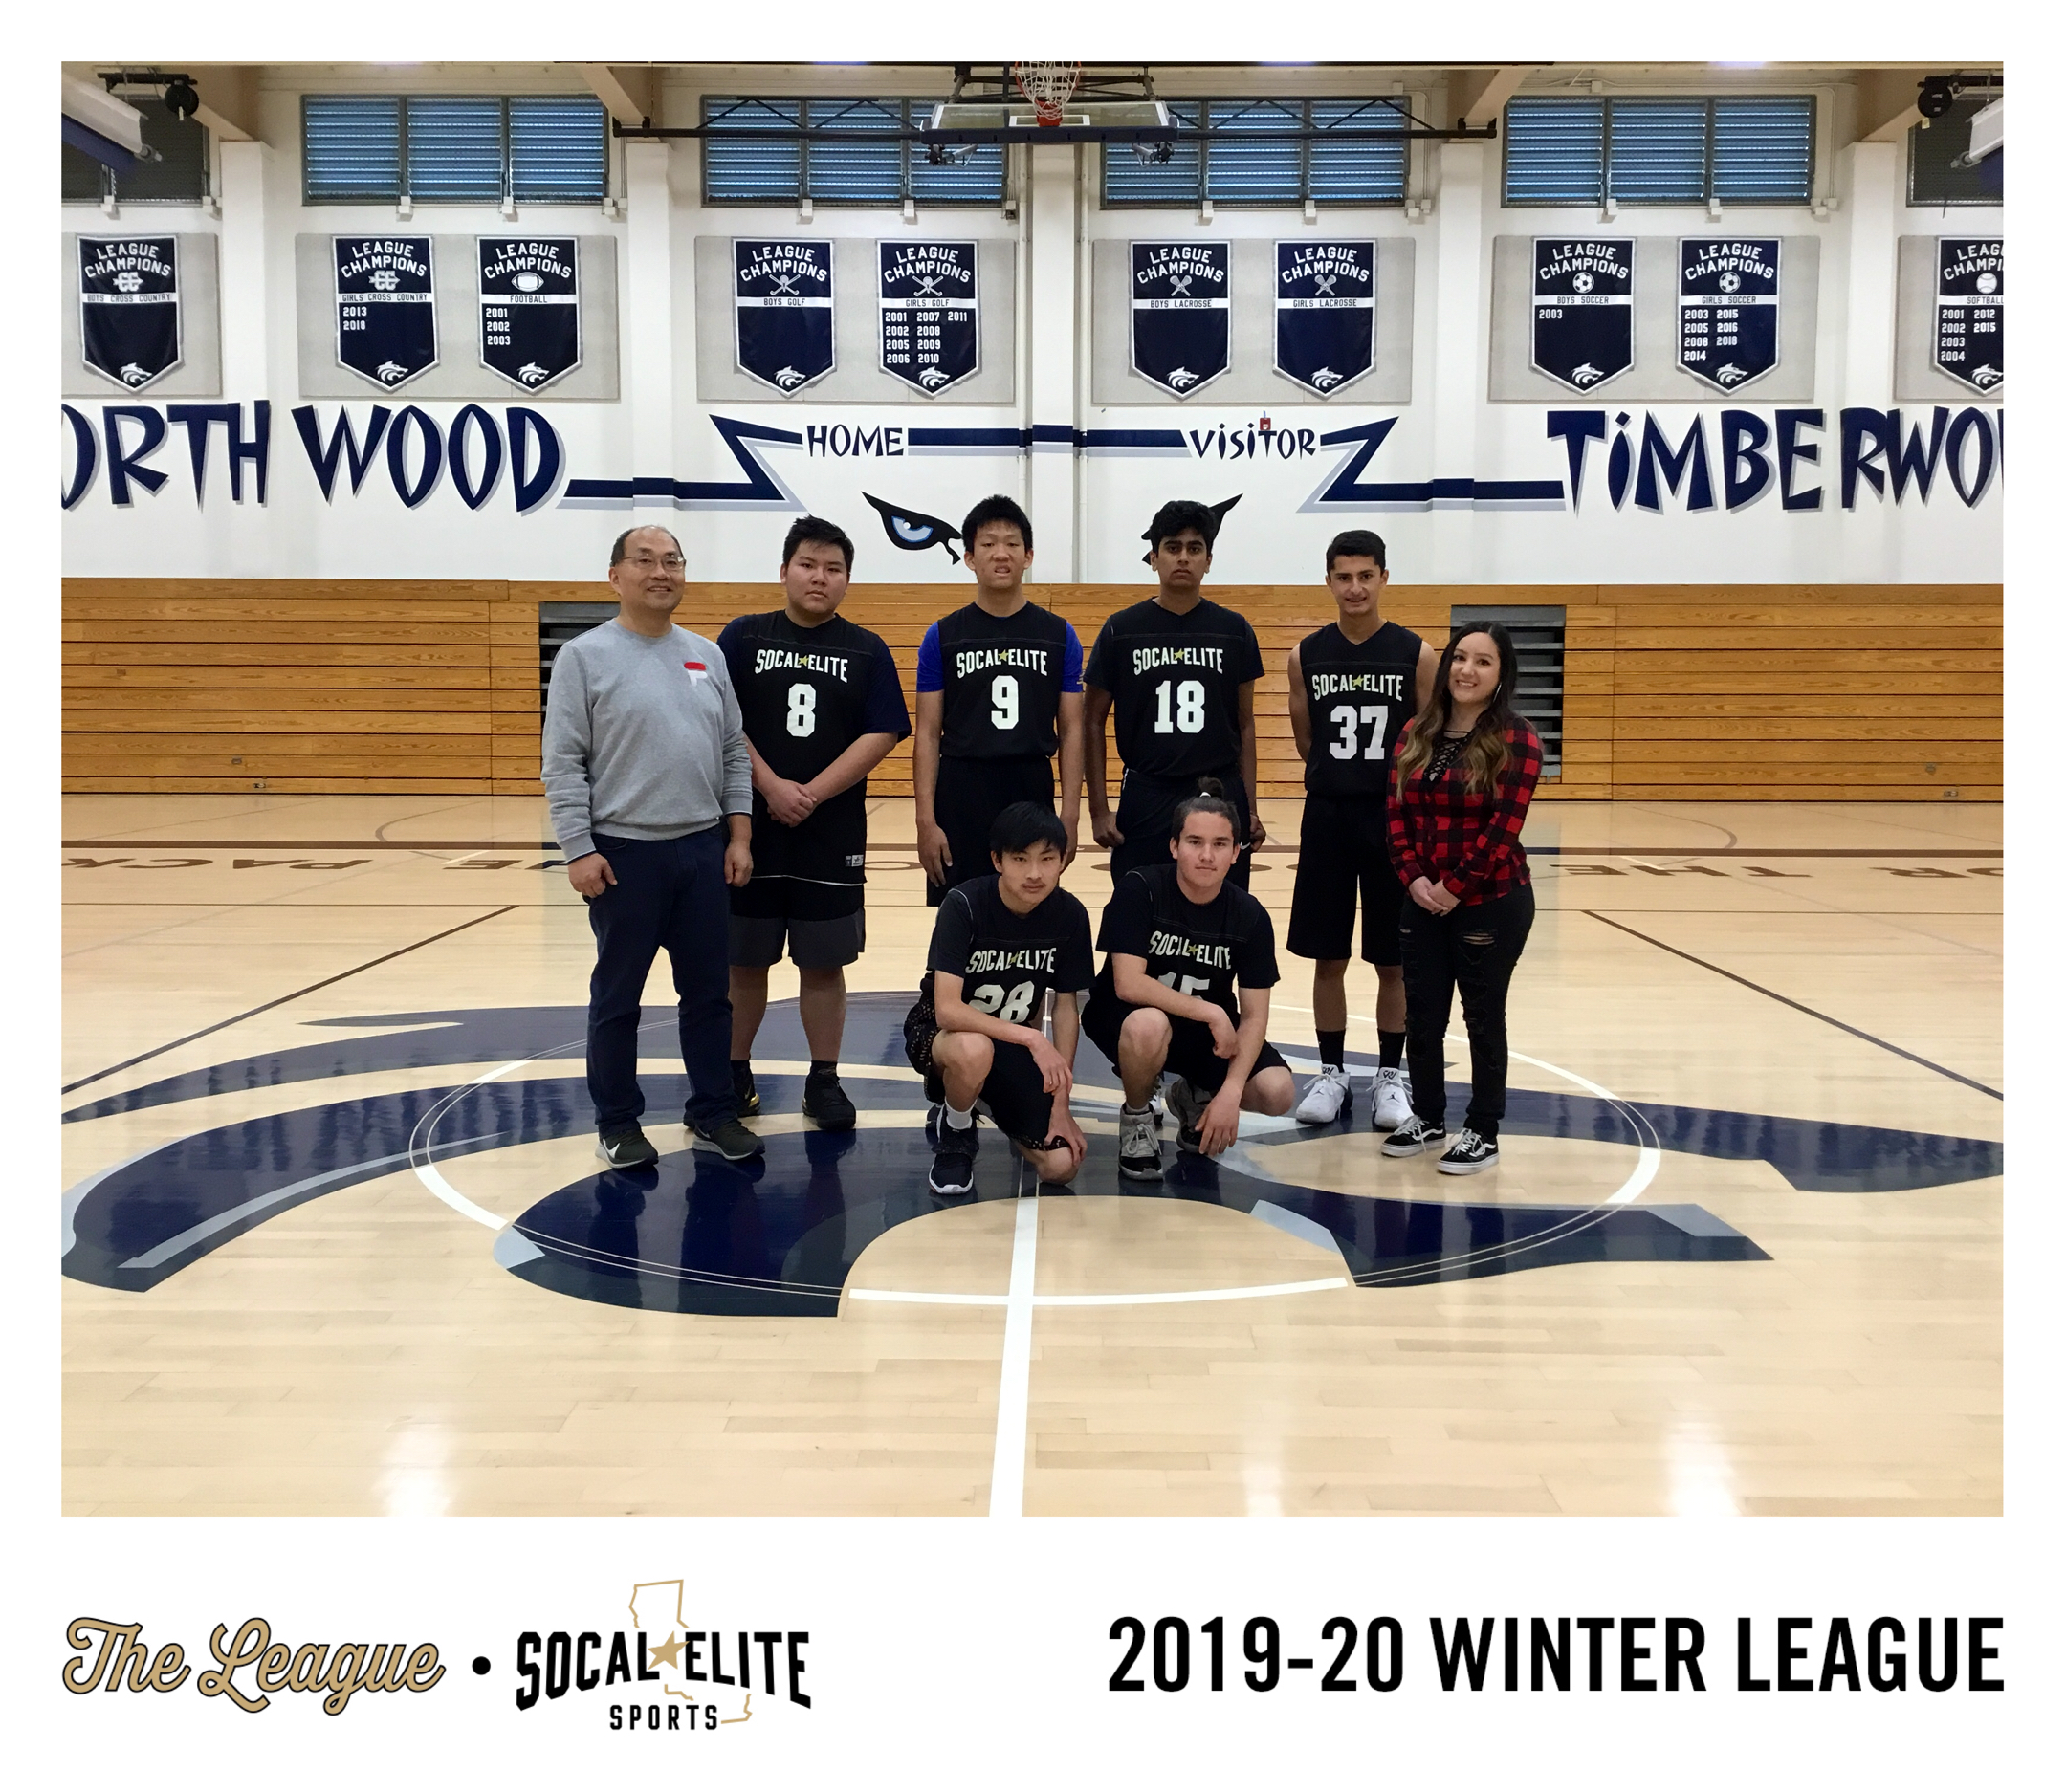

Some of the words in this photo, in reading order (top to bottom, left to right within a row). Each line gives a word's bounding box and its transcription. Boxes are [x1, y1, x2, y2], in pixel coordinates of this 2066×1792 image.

[97, 243, 160, 259] LEAGUE
[352, 241, 413, 258] LEAGUE
[496, 243, 559, 260] LEAGUE
[752, 245, 814, 262] LEAGUE
[896, 247, 958, 263] LEAGUE
[1294, 246, 1357, 263] LEAGUE
[1552, 243, 1616, 260] LEAGUE
[1699, 243, 1762, 261] LEAGUE
[1957, 243, 2003, 261] LEAG
[1150, 247, 1212, 264] LEAGUE
[84, 257, 171, 277] CHAMPIONS
[341, 256, 427, 278] CHAMPIONS
[484, 257, 571, 279] CHAMPIONS
[740, 260, 827, 281] CHAMPIONS
[884, 261, 970, 283] CHAMPIONS
[1282, 261, 1369, 283] CHAMPIONS
[1539, 258, 1628, 280] CHAMPIONS
[1685, 258, 1774, 280] CHAMPIONS
[1944, 258, 2003, 280] CHAMPI
[1137, 262, 1224, 284] CHAMPIONS
[87, 294, 104, 302] BOYS
[110, 294, 134, 302] CROSS
[139, 293, 170, 302] COUNTRY
[368, 293, 392, 301] CROSS
[510, 295, 548, 303] FOOTBALL
[764, 298, 782, 306] BOYS
[788, 298, 806, 306] GOLF
[1150, 300, 1169, 308] BOYS
[1319, 299, 1357, 307] LACROSSE
[343, 306, 367, 317] 2013
[485, 308, 507, 318] 2001
[885, 312, 907, 322] 2001
[917, 312, 940, 322] 2007
[948, 311, 967, 321] 2011
[1539, 309, 1562, 319] 2003
[1685, 309, 1709, 319] 2003
[1716, 309, 1738, 319] 2015
[1942, 309, 1964, 319] 2001
[1974, 309, 1995, 319] 2012
[343, 320, 366, 330] 2018
[486, 321, 510, 331] 2002
[1685, 323, 1709, 333] 2005
[1717, 322, 1738, 332] 2016
[1941, 323, 1965, 333] 2002
[1974, 322, 1996, 332] 2015
[886, 326, 909, 336] 2002
[917, 326, 941, 336] 2008
[487, 335, 510, 345] 2003
[886, 340, 909, 350] 2005
[918, 340, 941, 350] 2009
[1684, 337, 1708, 347] 2008
[1716, 336, 1737, 346] 2018
[1941, 337, 1965, 347] 2003
[887, 353, 910, 363] 2006
[918, 353, 939, 363] 2010
[1684, 350, 1706, 361] 2014
[1941, 351, 1965, 361] 2004
[807, 424, 904, 457] HOME
[291, 404, 565, 516] WOOD
[755, 649, 802, 675] SOCAL
[808, 654, 849, 683] ELITE
[956, 649, 1002, 678] SOCAL
[1008, 649, 1048, 677] ELITE
[1133, 647, 1177, 676] SOCAL
[1184, 648, 1224, 674] ELITE
[1311, 674, 1356, 701] SOCAL
[1363, 674, 1404, 701] ELITE
[991, 675, 1019, 729] 9
[1154, 680, 1205, 733] 18
[786, 683, 816, 738] 8
[1329, 705, 1388, 760] 37
[1149, 930, 1190, 957] SOCAL
[1196, 944, 1231, 970] ELITE
[965, 949, 1012, 974] SOCAL
[1016, 947, 1057, 974] ELITE
